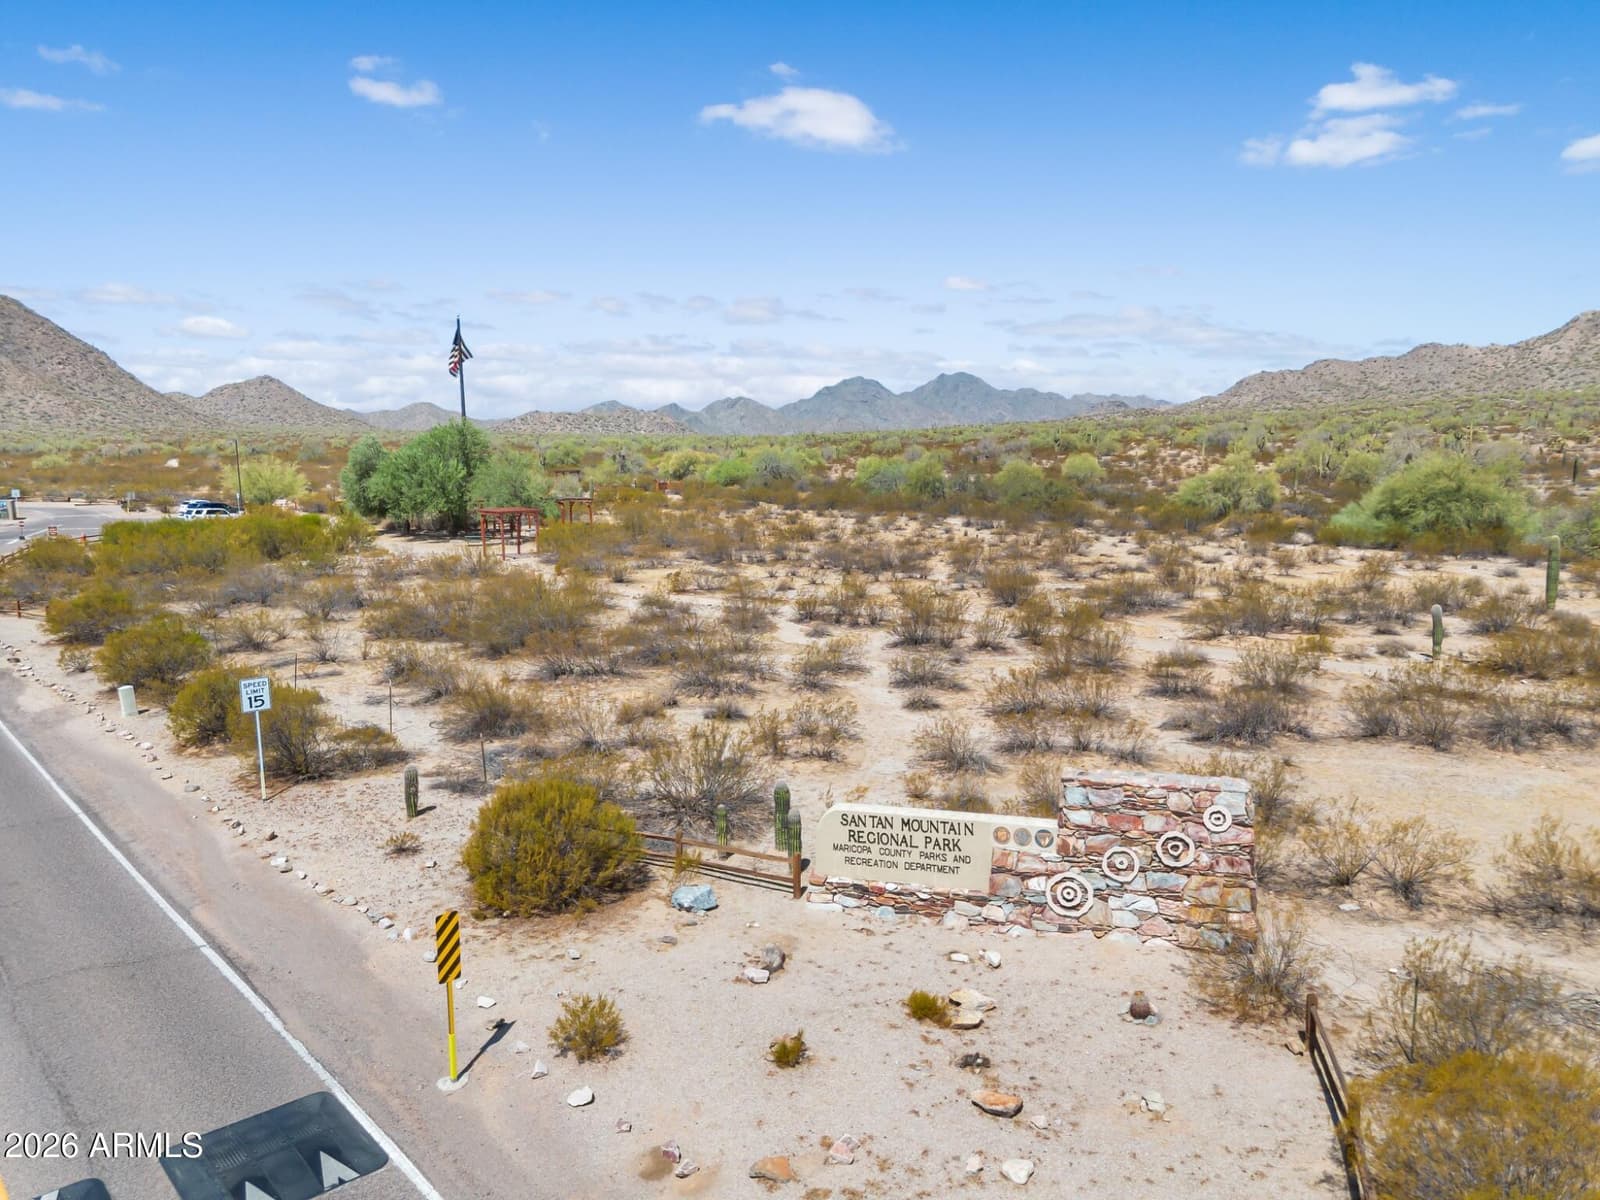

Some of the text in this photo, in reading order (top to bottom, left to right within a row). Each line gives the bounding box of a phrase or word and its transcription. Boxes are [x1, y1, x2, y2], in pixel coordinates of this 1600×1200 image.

[243, 680, 267, 689] SPEED
[248, 695, 265, 709] 15
[901, 818, 974, 836] MOUNTAIN
[848, 829, 962, 852] REGIONAL PARK
[832, 843, 971, 864] MARICOPA COUNTY PARKS AND
[844, 856, 960, 874] RECREATION DEPARTMENT
